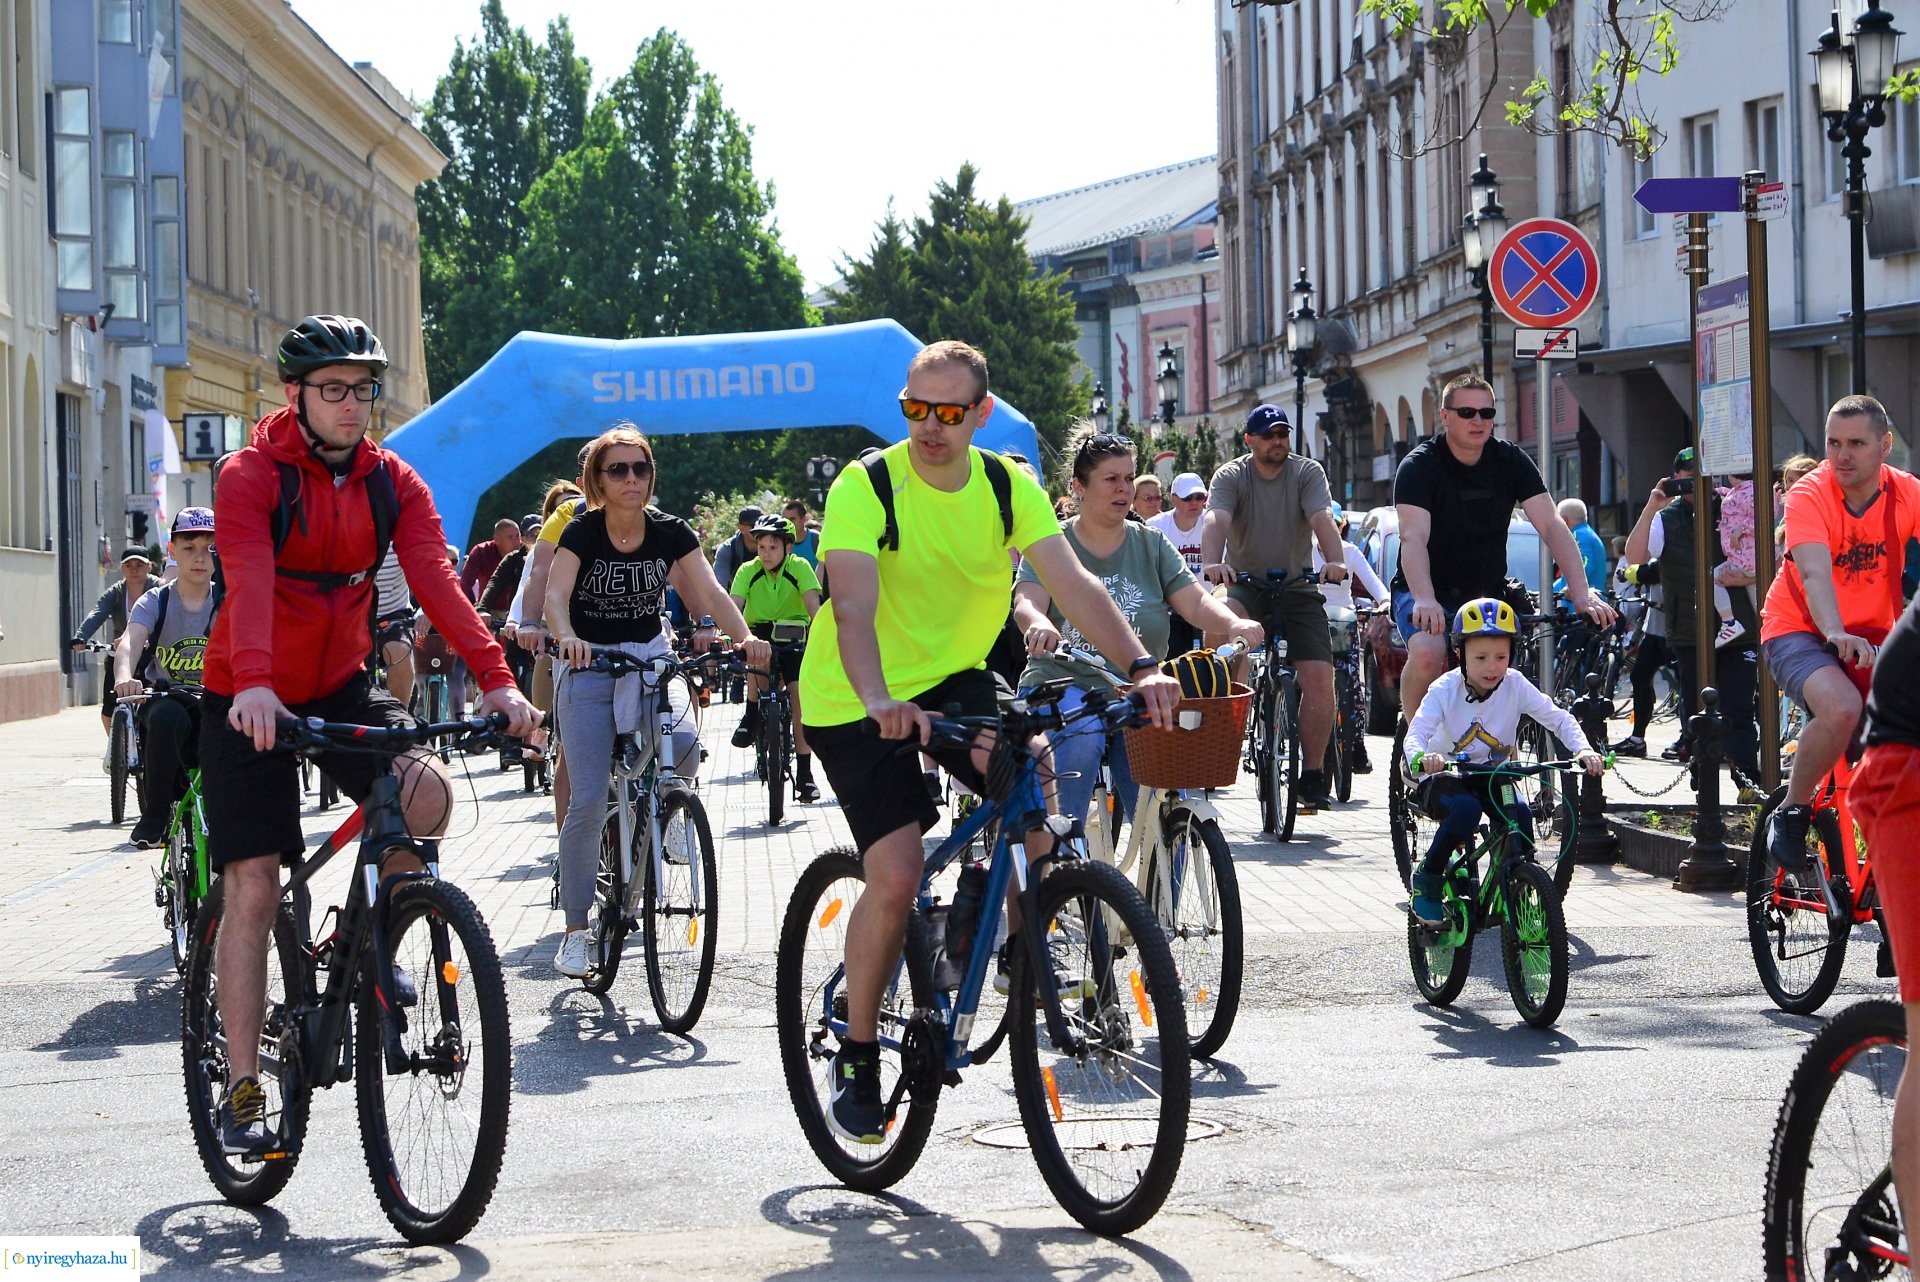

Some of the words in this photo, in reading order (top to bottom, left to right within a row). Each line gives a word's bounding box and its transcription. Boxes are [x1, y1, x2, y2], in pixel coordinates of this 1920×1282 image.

[592, 361, 816, 403] SHIMANO
[1185, 554, 1202, 563] TUD
[582, 558, 668, 595] RETRO
[584, 610, 602, 618] TEST
[605, 611, 629, 619] SINCE
